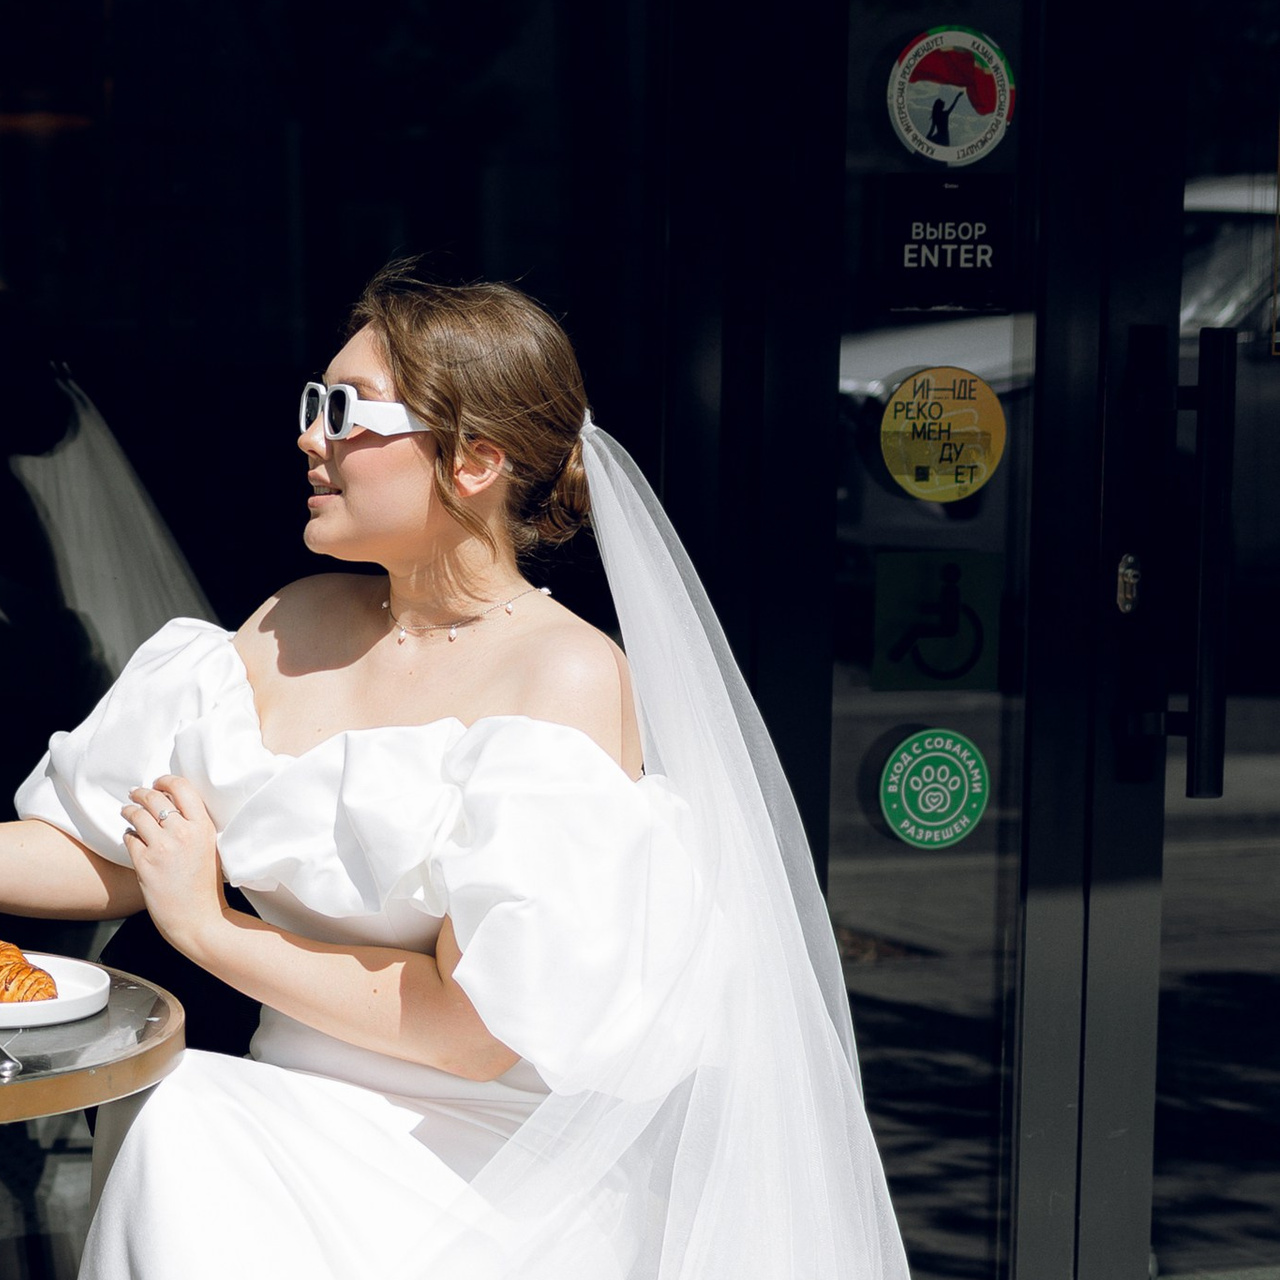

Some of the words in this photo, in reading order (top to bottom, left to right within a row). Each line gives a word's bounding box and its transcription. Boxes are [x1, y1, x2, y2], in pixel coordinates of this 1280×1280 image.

[900, 36, 944, 80] РЕКОМЕНДУЕТ
[971, 40, 993, 64] КАЗАНЬ
[992, 64, 1007, 118] ИНТЕРЕСНАЯ
[896, 81, 912, 133] ИНТЕРЕСНАЯ
[912, 132, 935, 155] КАЗАНЬ
[956, 118, 1001, 160] РЕКОМЕНДУЕТ
[912, 222, 987, 240] ВЫБОР
[904, 244, 993, 268] ENTER
[894, 402, 943, 420] РЕКО
[911, 422, 951, 440] МЕН
[939, 442, 964, 464] ДУ
[955, 465, 978, 484] ЕТ
[887, 752, 913, 793] ВХОД
[911, 742, 922, 754] С
[924, 737, 982, 793] СОБАКАМИ
[900, 815, 971, 842] РАЗРЕШЕН
